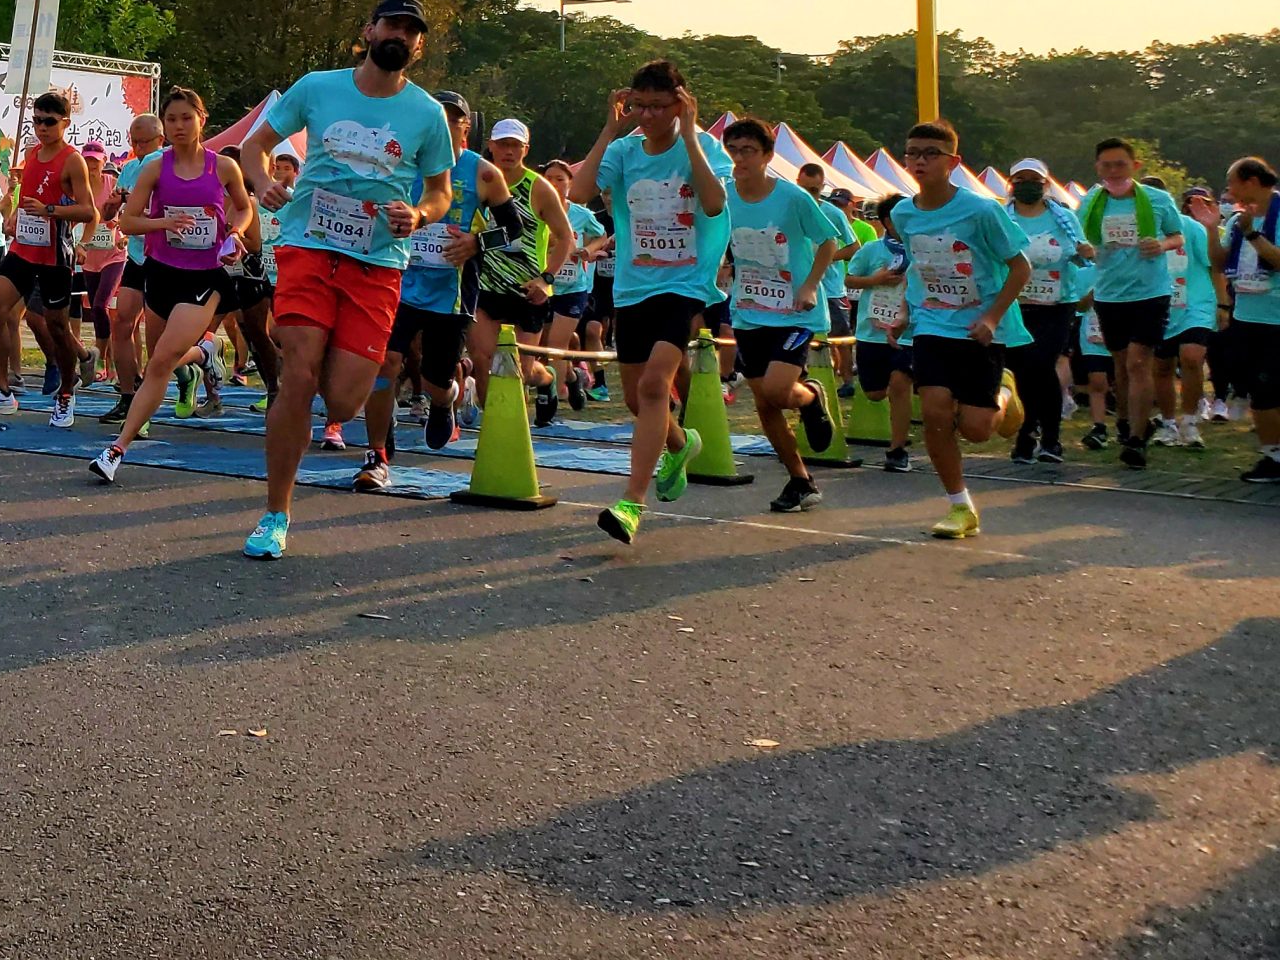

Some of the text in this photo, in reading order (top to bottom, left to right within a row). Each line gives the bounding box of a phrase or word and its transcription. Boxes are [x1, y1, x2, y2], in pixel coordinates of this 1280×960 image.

[20, 225, 45, 235] 11009
[317, 215, 364, 238] 11084
[640, 238, 686, 250] 61011
[745, 285, 785, 298] 61010
[928, 283, 969, 295] 61012
[1022, 285, 1054, 294] 2124
